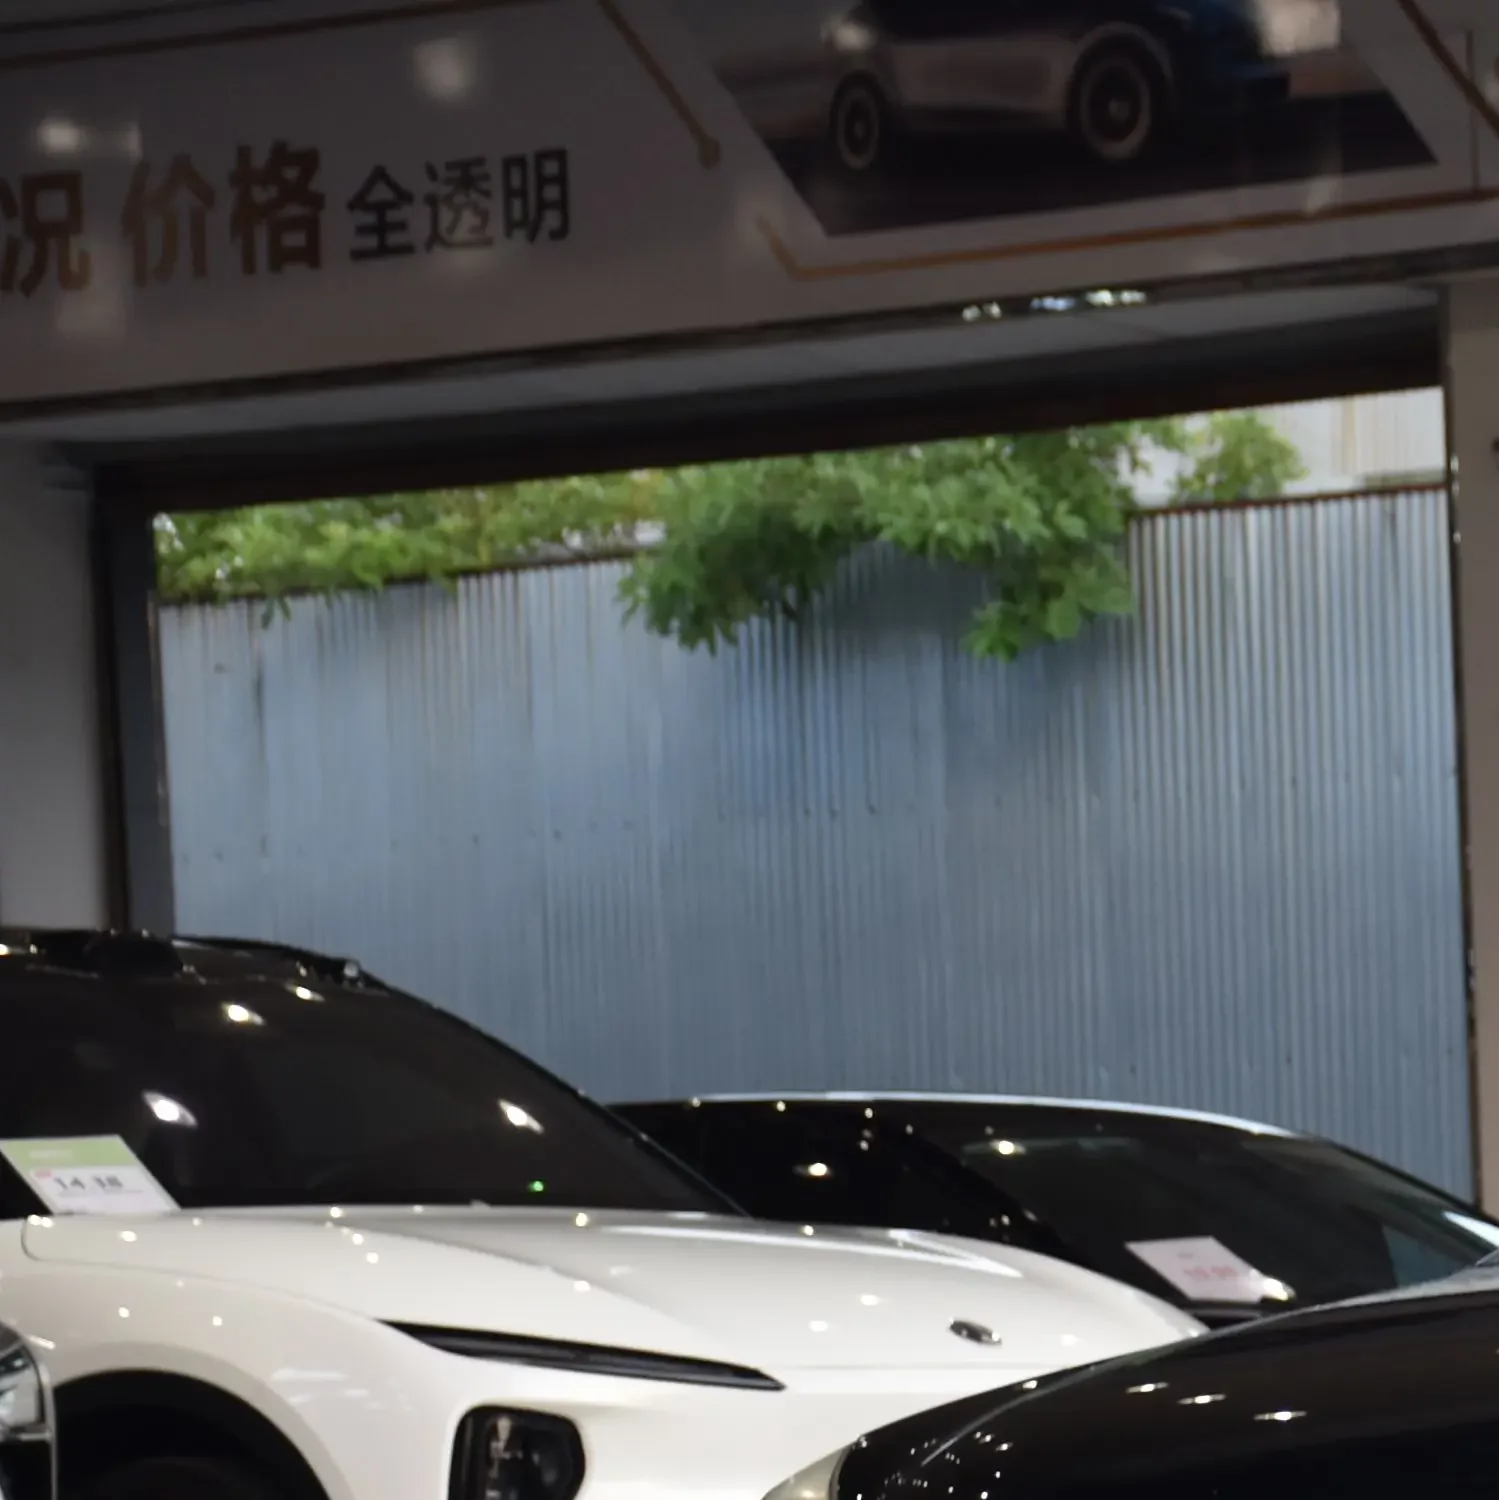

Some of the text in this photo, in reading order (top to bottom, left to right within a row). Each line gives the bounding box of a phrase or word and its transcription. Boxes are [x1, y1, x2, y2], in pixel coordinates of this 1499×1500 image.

[0, 140, 571, 297] 况 价格 全透明
